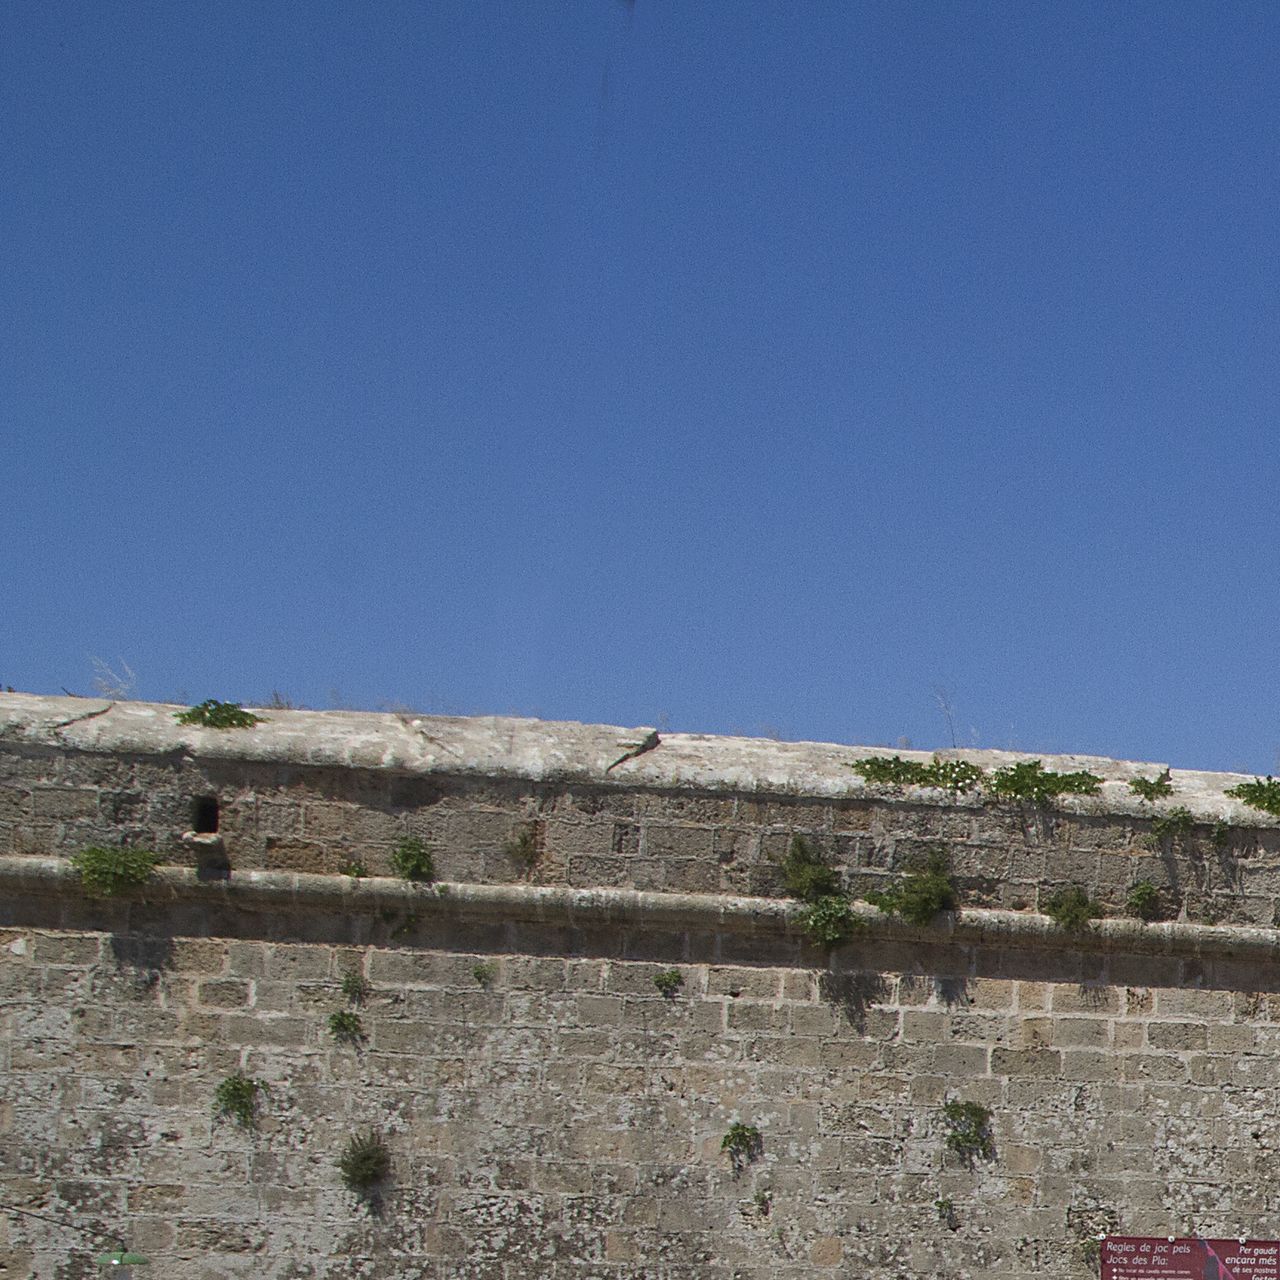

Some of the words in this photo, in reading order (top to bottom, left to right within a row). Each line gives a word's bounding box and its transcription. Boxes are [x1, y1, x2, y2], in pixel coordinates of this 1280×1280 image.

[1140, 1242, 1151, 1252] de
[1153, 1243, 1168, 1254] joc
[1172, 1243, 1191, 1255] pels
[1239, 1246, 1251, 1254] Per
[1253, 1247, 1278, 1256] gaudir
[1106, 1254, 1128, 1264] Jocs
[1132, 1255, 1148, 1265] des
[1225, 1257, 1256, 1265] encara
[1258, 1256, 1277, 1265] més
